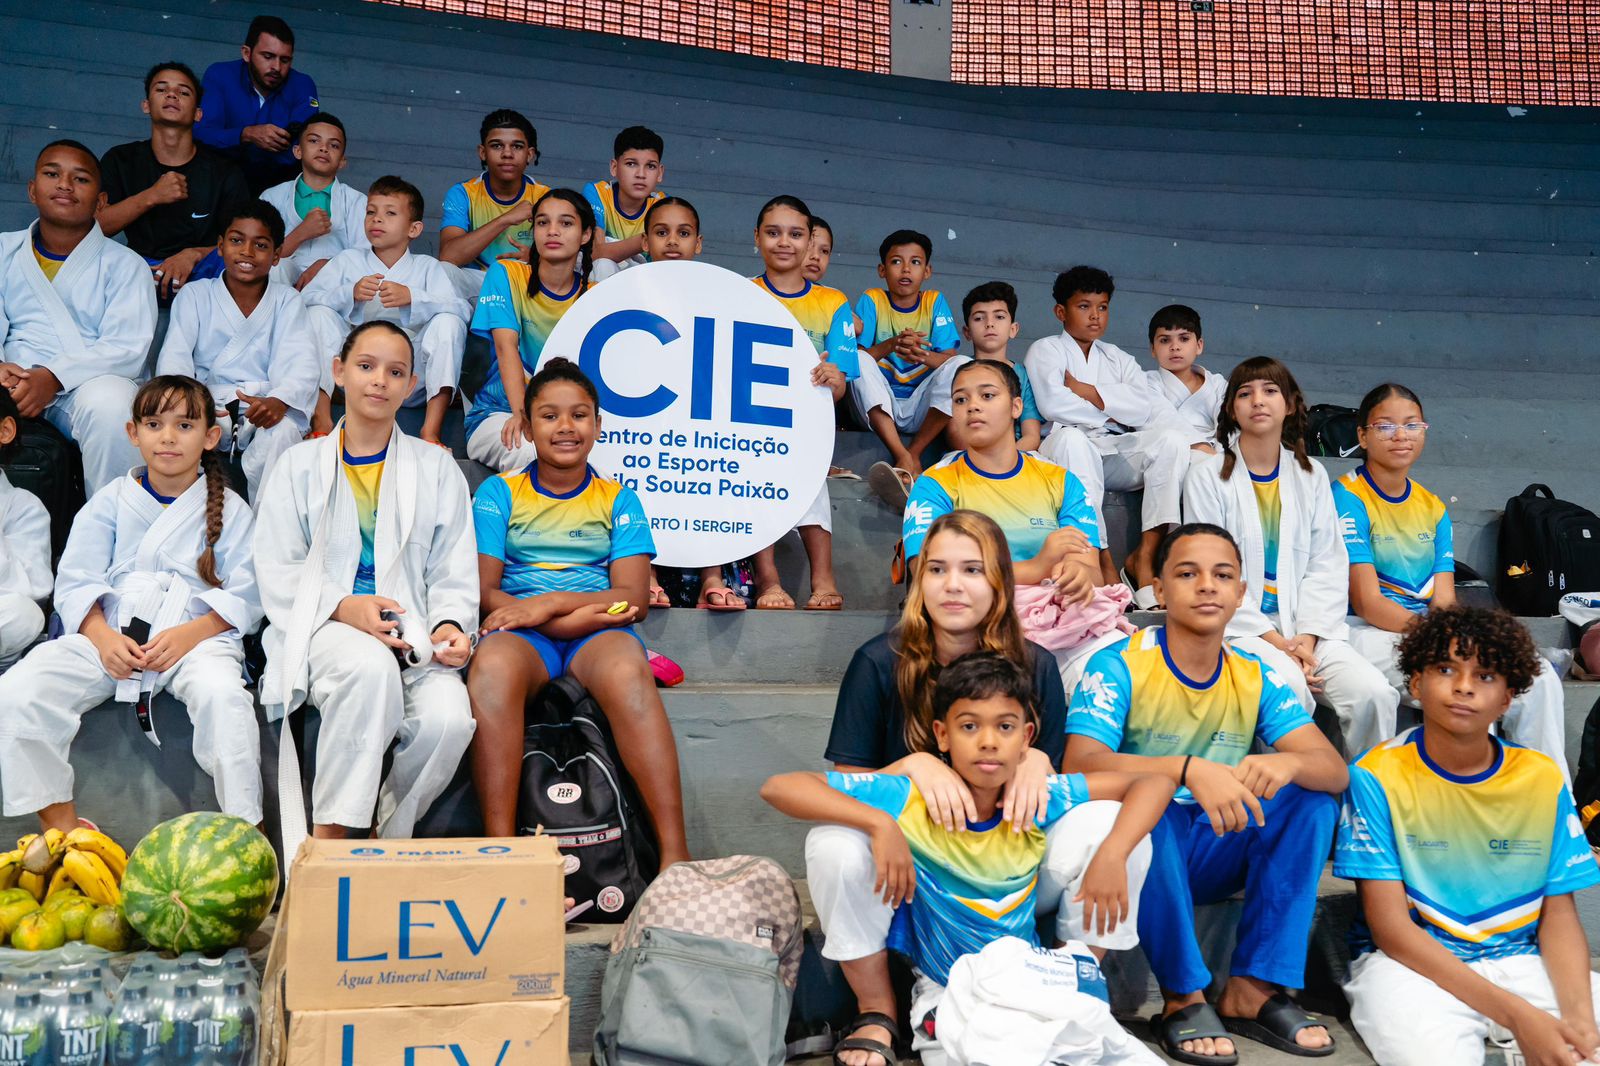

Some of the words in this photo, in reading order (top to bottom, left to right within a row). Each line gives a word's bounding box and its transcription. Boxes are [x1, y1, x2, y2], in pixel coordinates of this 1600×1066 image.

[579, 309, 794, 429] CIE
[596, 428, 653, 446] entro
[659, 429, 687, 448] de
[694, 431, 789, 457] Iniciação
[622, 454, 652, 469] ao
[658, 452, 740, 475] Esporte
[645, 474, 712, 496] Souza
[718, 478, 789, 501] Paixão
[568, 530, 583, 538] CIE
[692, 519, 753, 535] SERGIPE
[1488, 839, 1509, 850] CIE
[337, 877, 506, 962] LEV
[337, 970, 373, 989] Água
[377, 968, 432, 984] Mineral
[435, 966, 488, 982] Natural
[0, 1032, 29, 1060] NT
[60, 1026, 101, 1055] TNT
